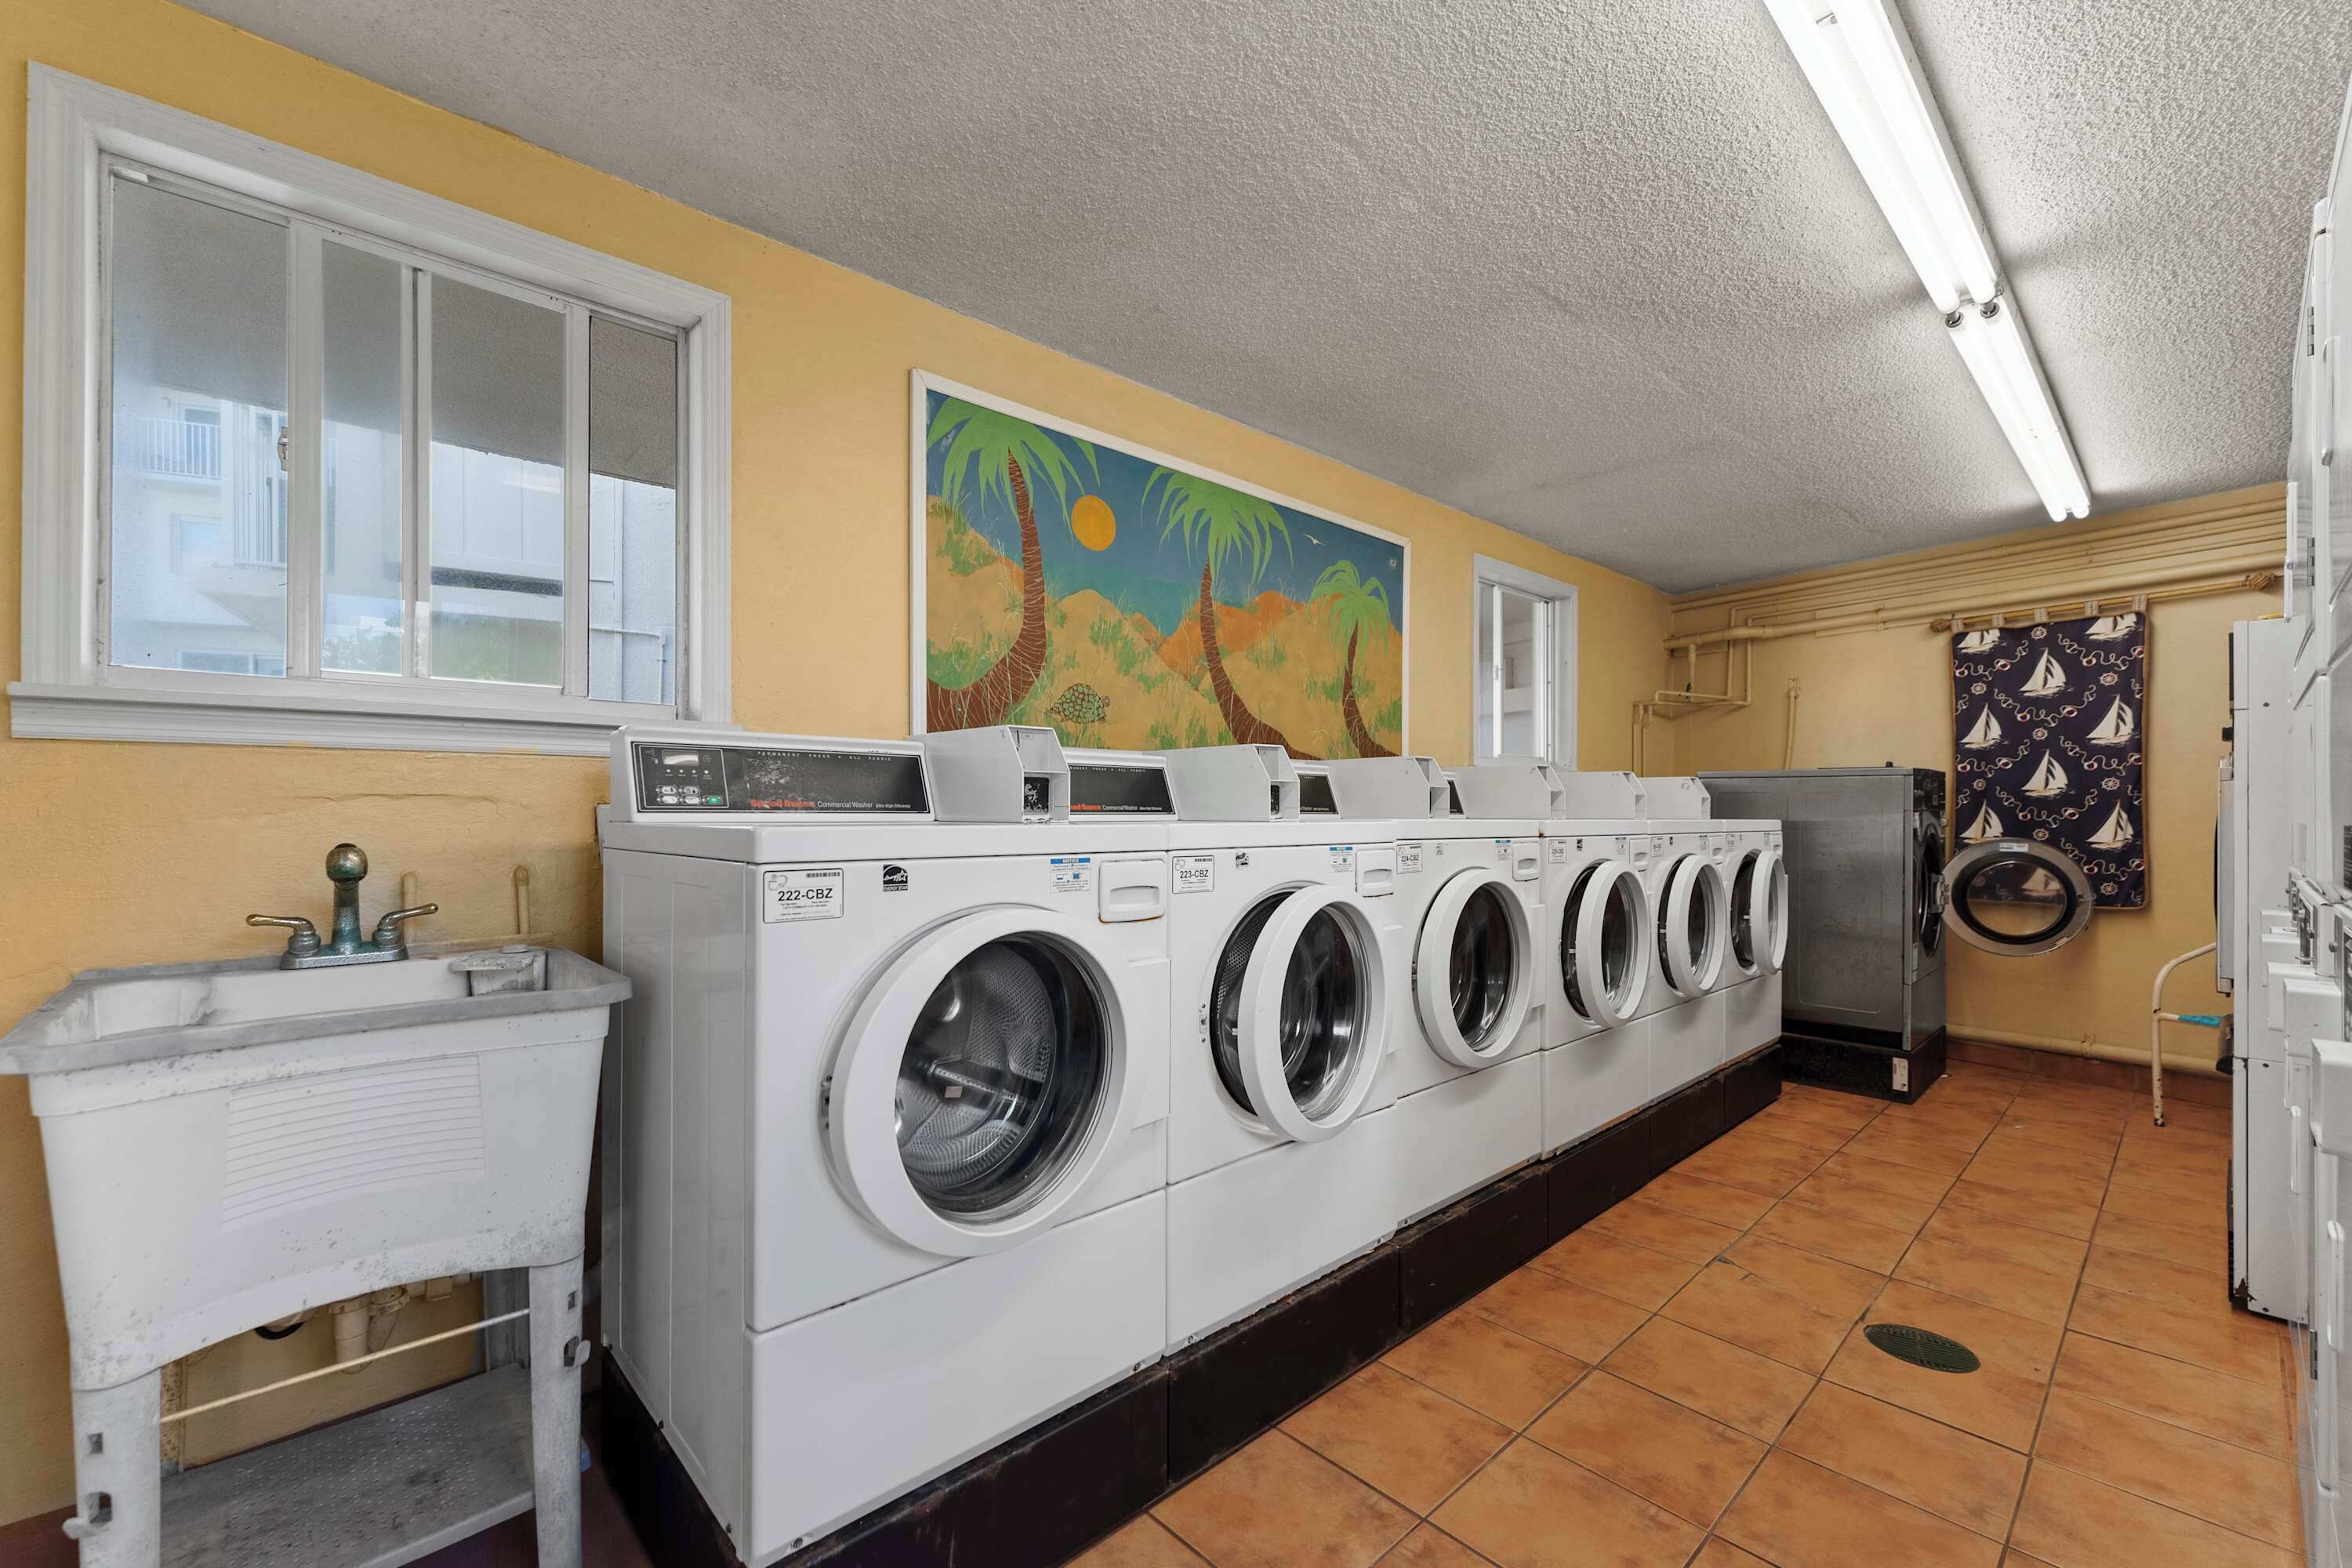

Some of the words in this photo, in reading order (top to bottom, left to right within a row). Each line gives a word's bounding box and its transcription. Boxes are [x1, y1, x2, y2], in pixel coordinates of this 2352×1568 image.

[750, 798, 782, 808] Speed
[784, 798, 815, 808] Queen
[1179, 869, 1209, 879] 223-CBZ
[778, 887, 833, 902] 222-CBZ
